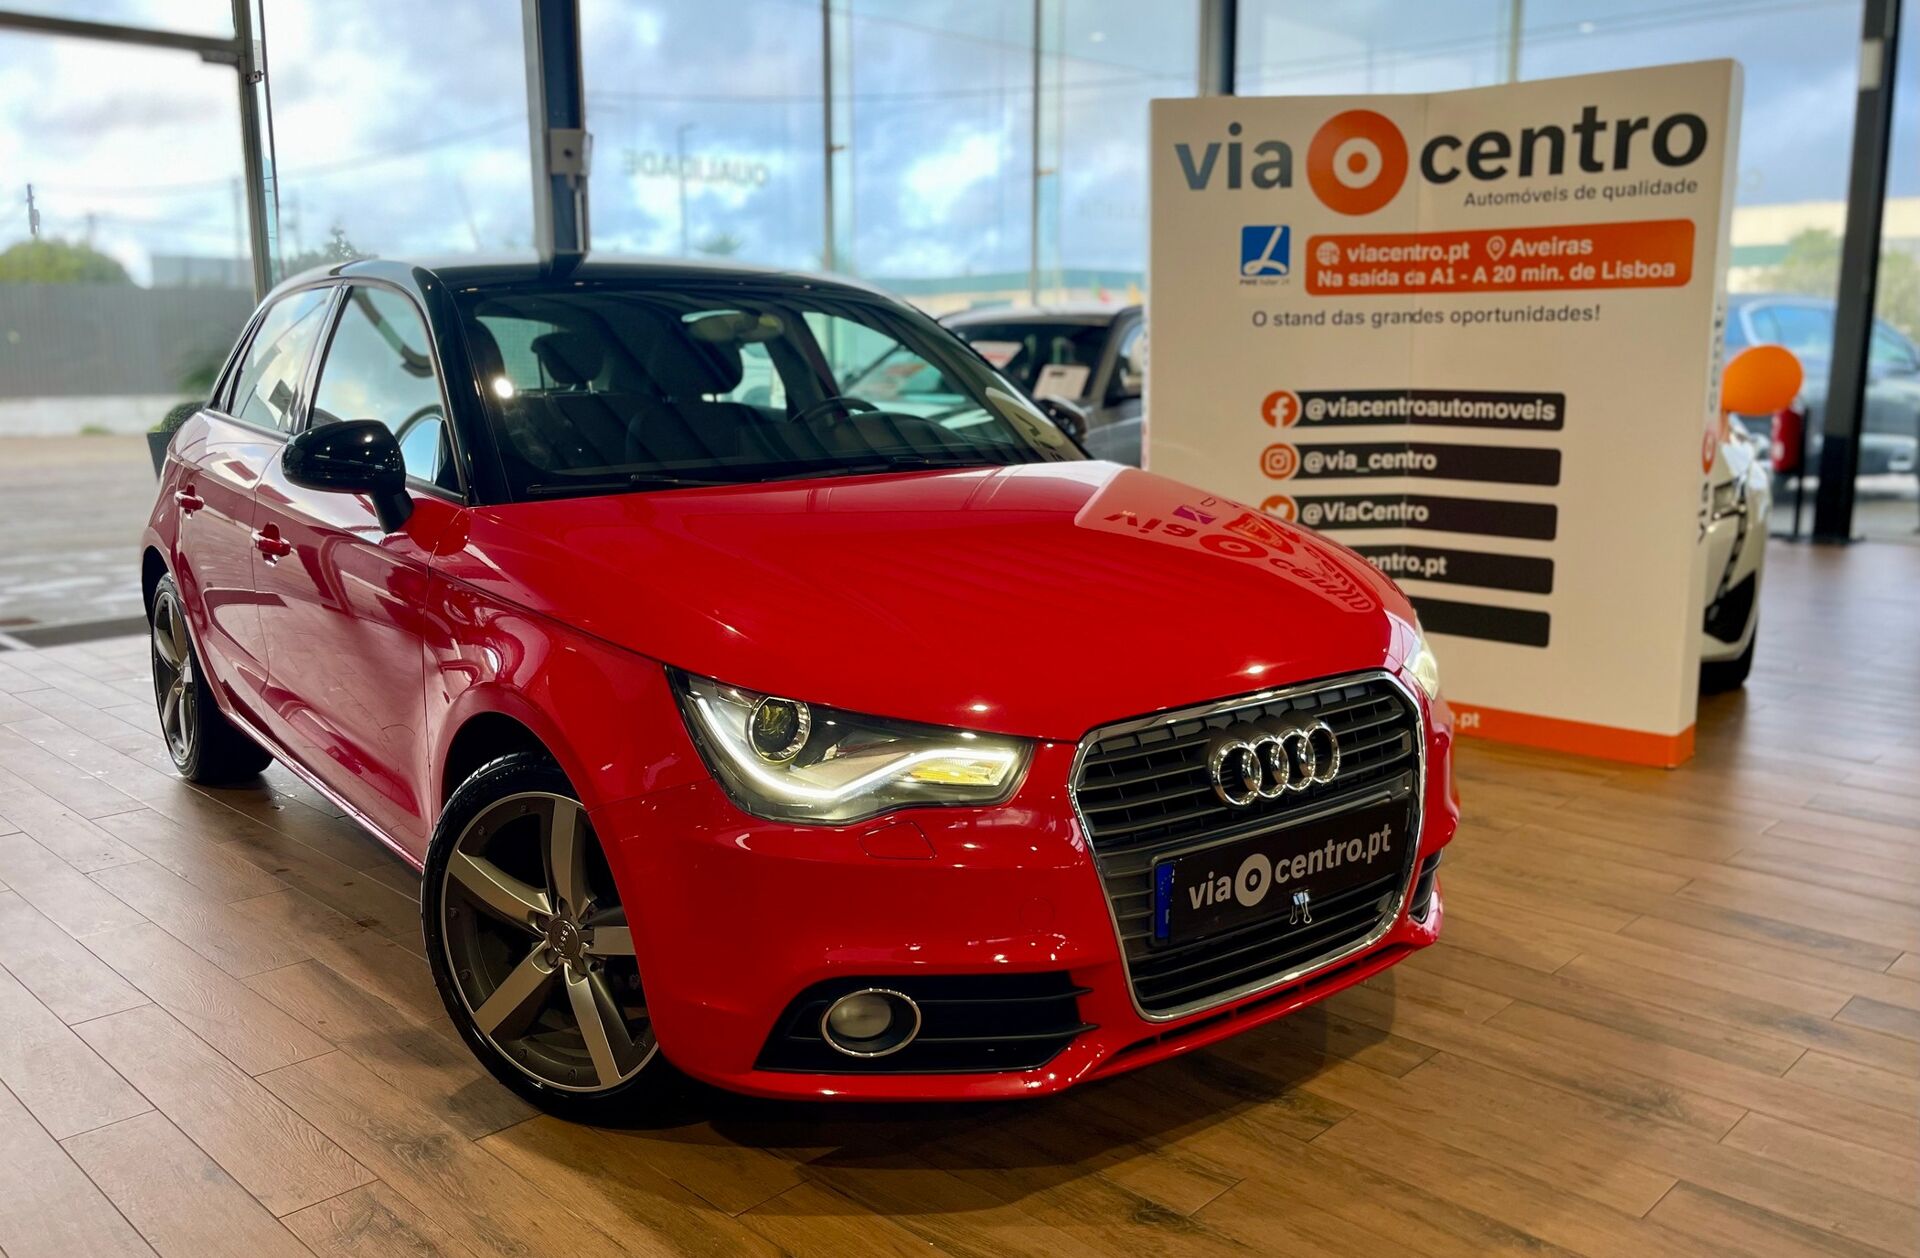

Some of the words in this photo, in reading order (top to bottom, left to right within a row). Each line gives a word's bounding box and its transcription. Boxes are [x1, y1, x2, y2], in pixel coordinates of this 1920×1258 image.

[1173, 121, 1293, 191] via
[1419, 105, 1708, 184] centro
[1463, 184, 1568, 208] Automóveis
[1574, 183, 1597, 201] de
[1602, 178, 1698, 202] qualidade
[1346, 241, 1470, 264] viacentro.pt
[1509, 236, 1593, 257] Aveiras
[1317, 270, 1343, 287] Na
[1348, 268, 1399, 287] saída
[1430, 267, 1455, 285] A1
[1472, 266, 1488, 284] A
[1493, 265, 1517, 283] 20
[1521, 262, 1565, 282] min.
[1569, 262, 1596, 280] de
[1602, 260, 1676, 279] Lisboa
[1252, 310, 1268, 328] O
[1273, 309, 1326, 327] stand
[1331, 309, 1365, 325] das
[1371, 308, 1444, 329] grandes
[1450, 304, 1601, 327] oportunidades!
[1305, 396, 1557, 421] @viacentroautomoveis
[1303, 450, 1437, 473] @via_centro
[1302, 501, 1429, 525] @ViaCentro
[1367, 551, 1447, 578] entro.pt
[1188, 871, 1232, 910] via
[1274, 823, 1392, 884] centro.pt
